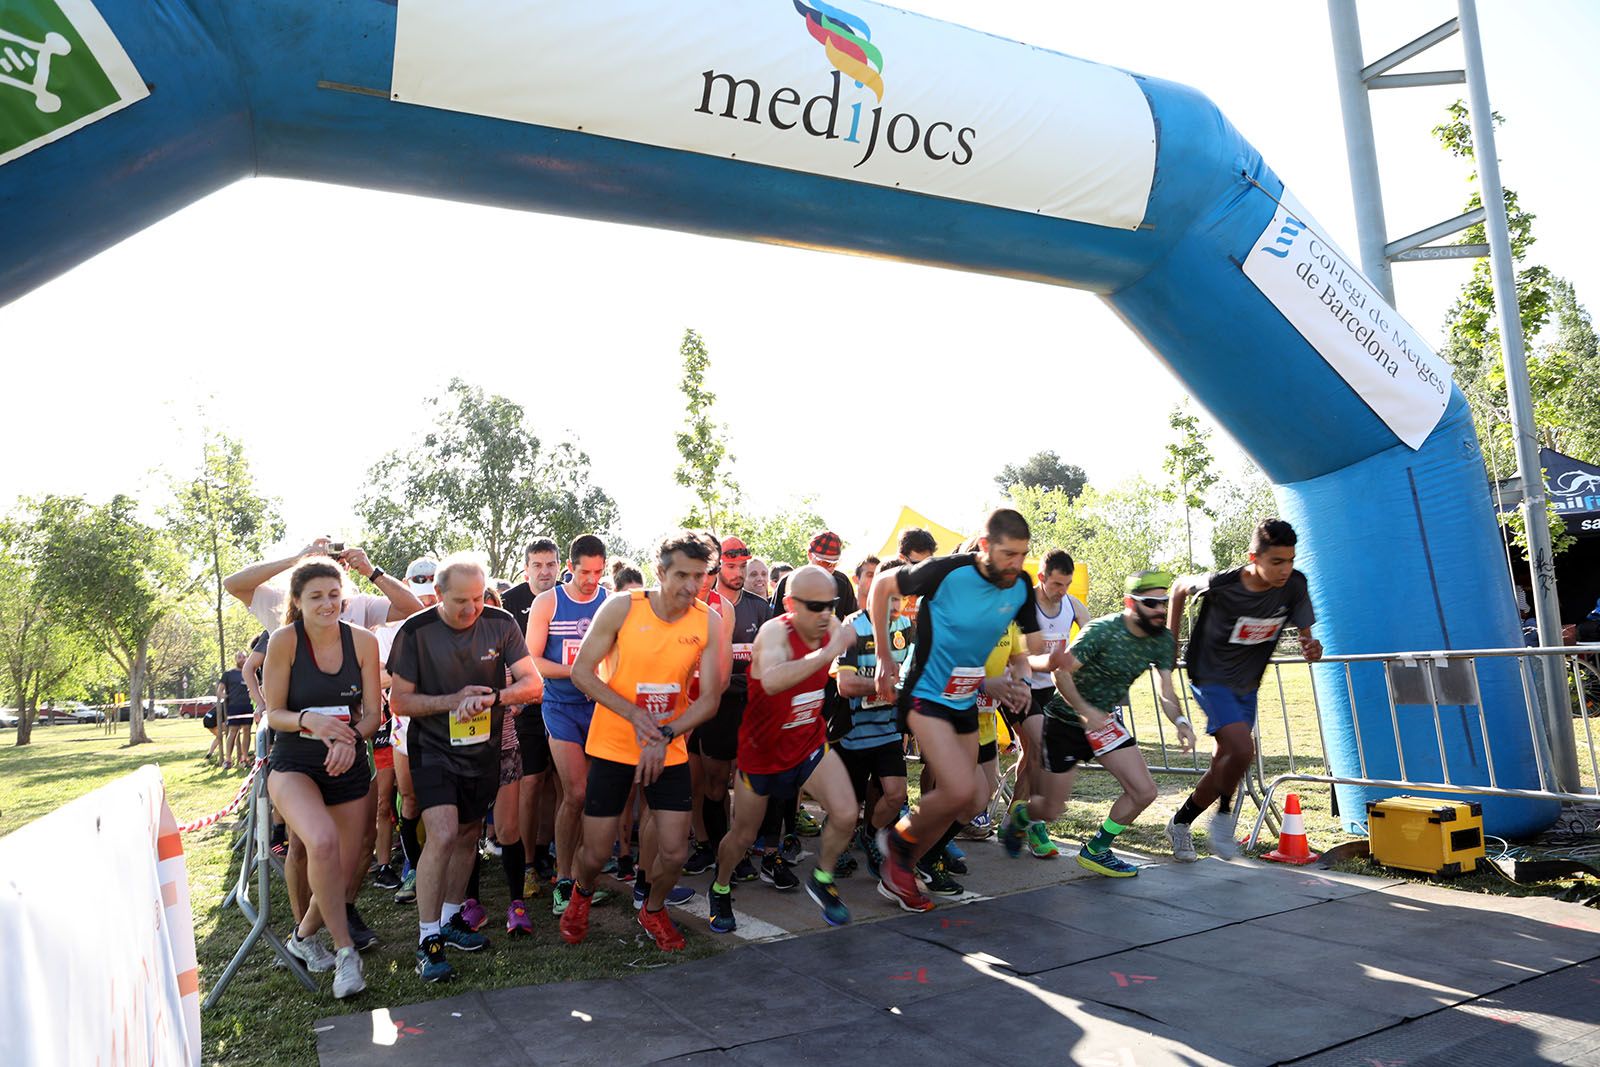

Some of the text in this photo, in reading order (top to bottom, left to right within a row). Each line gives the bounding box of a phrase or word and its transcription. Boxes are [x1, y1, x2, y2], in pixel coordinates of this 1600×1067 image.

[694, 69, 976, 168] medijocs
[1296, 261, 1400, 379] de Barcelona
[1369, 307, 1389, 334] de
[469, 725, 476, 737] 3
